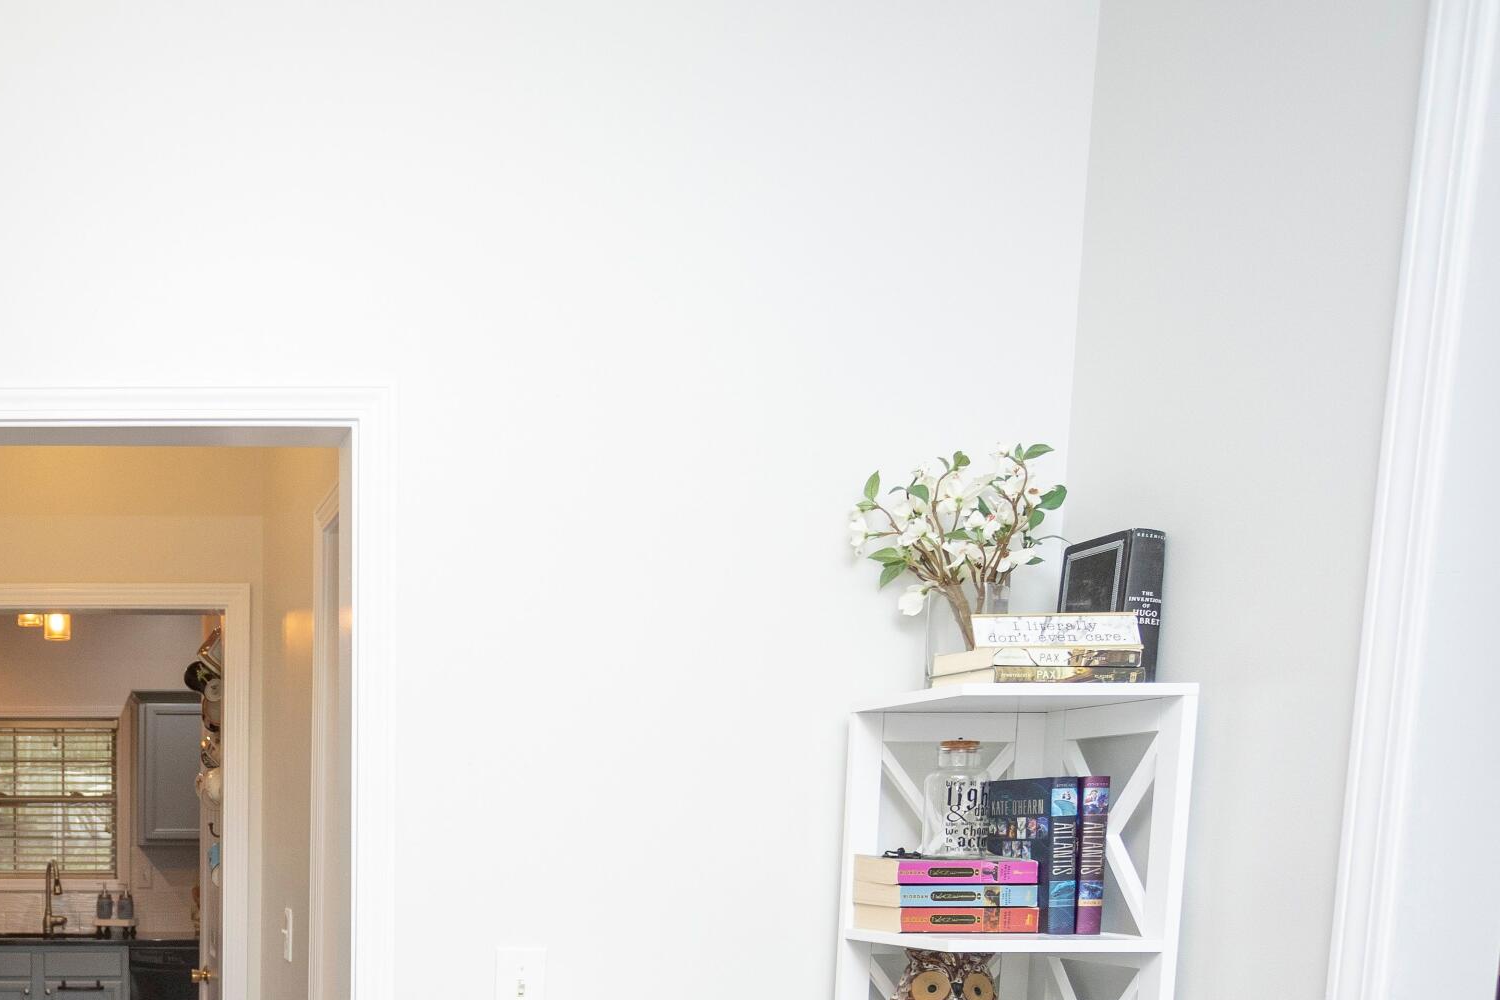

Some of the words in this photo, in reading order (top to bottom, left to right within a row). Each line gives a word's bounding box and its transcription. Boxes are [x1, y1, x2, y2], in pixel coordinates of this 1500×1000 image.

[1128, 596, 1162, 604] INVENTION
[1132, 609, 1158, 617] HUGO
[1027, 620, 1097, 633] literally
[988, 632, 1030, 643] don't
[1038, 633, 1077, 642] even
[1085, 632, 1128, 642] care.
[1039, 653, 1060, 662] PAX
[1036, 669, 1056, 679] PAX
[946, 804, 967, 822] &
[991, 800, 1009, 816] KATE
[1052, 822, 1074, 875] ATLANTIS
[1080, 821, 1103, 875] ATLANTIS
